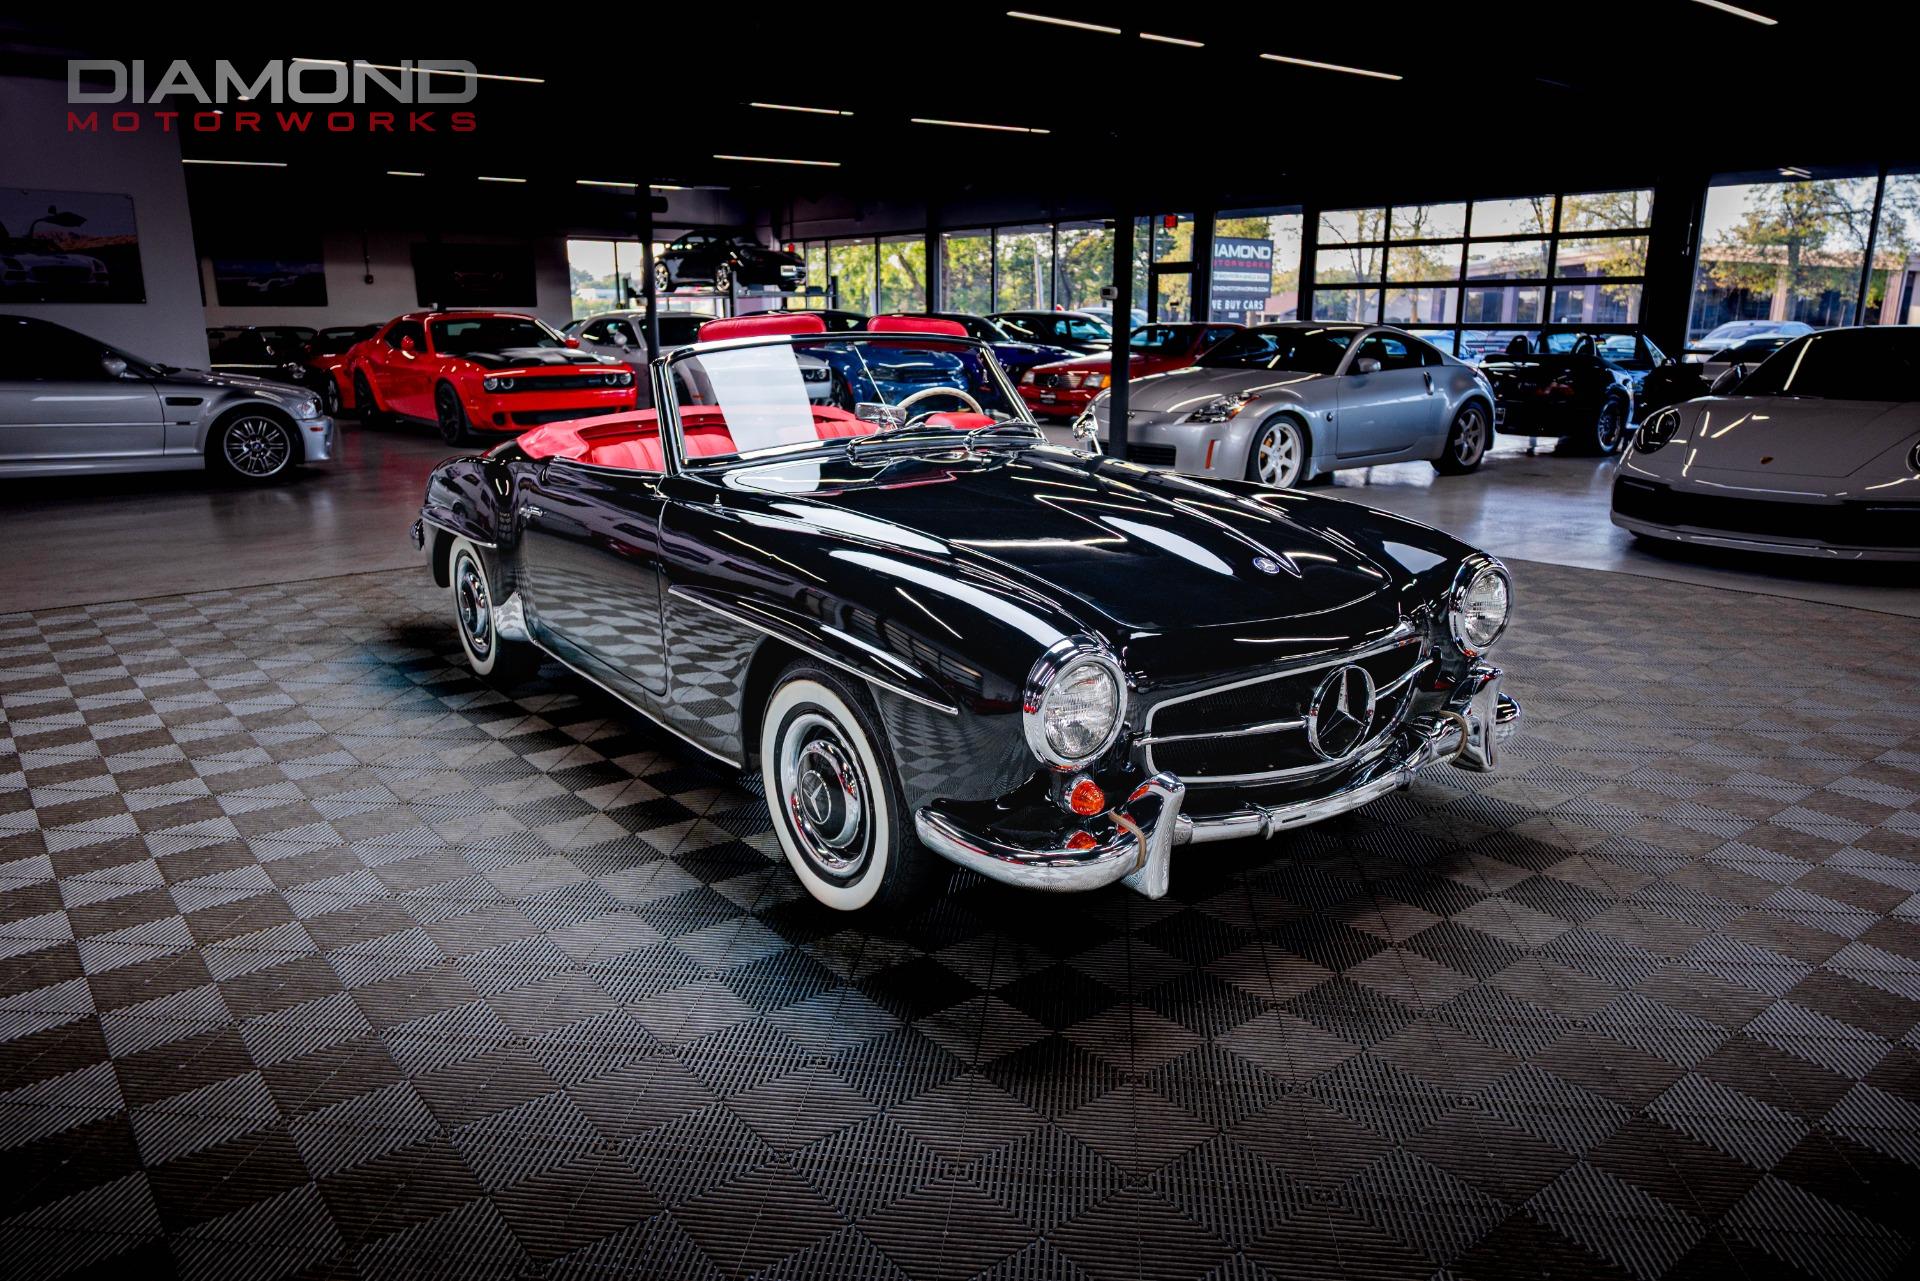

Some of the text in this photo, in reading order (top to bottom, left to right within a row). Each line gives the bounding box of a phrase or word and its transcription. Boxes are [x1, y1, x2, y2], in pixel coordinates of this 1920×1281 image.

[1214, 244, 1271, 259] IAMOND
[1213, 259, 1270, 268] TORWORKS
[1225, 299, 1241, 309] BUY
[1243, 300, 1264, 310] CARS
